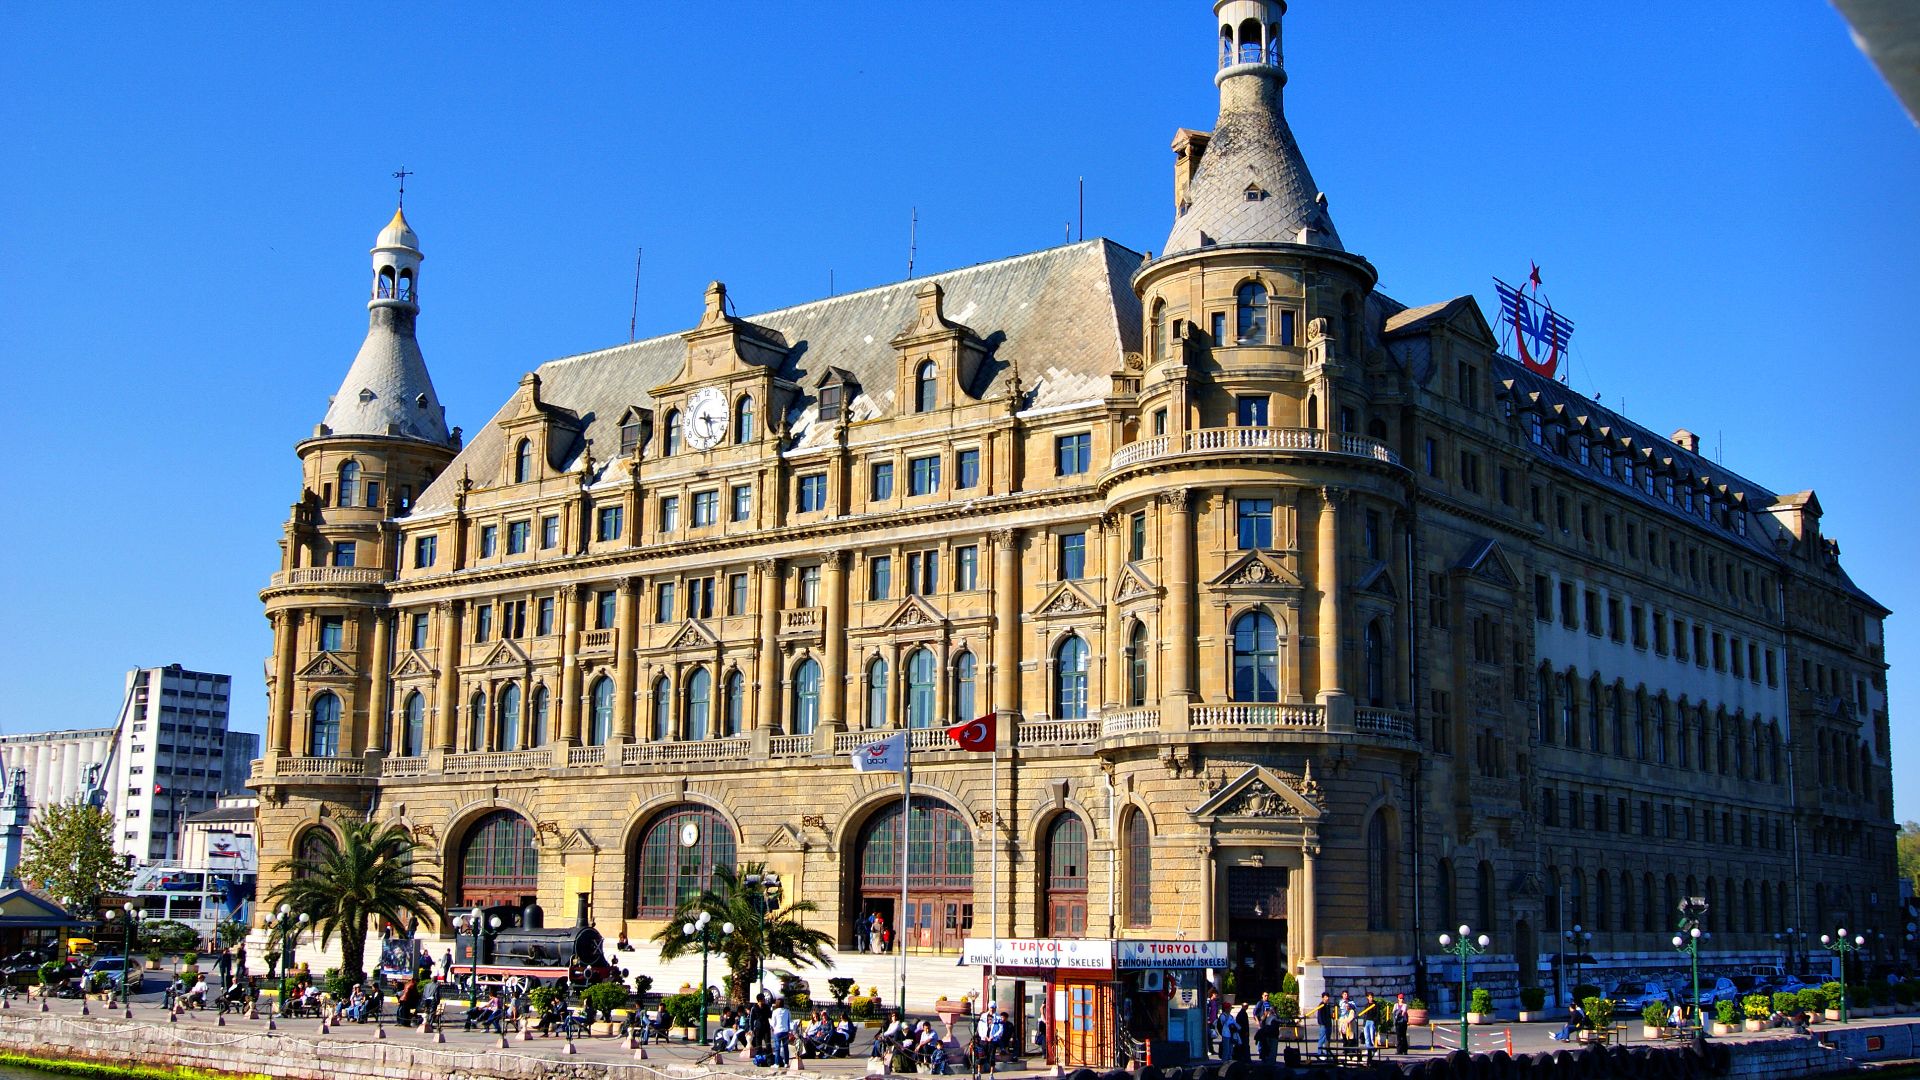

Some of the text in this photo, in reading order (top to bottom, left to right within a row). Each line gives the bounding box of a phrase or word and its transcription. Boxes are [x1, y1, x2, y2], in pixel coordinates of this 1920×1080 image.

[1011, 942, 1063, 951] TURYOL
[1150, 944, 1197, 953] TURYOL
[1068, 956, 1104, 967] İSKELESİ
[1118, 957, 1152, 967] EMİNÖNÜ
